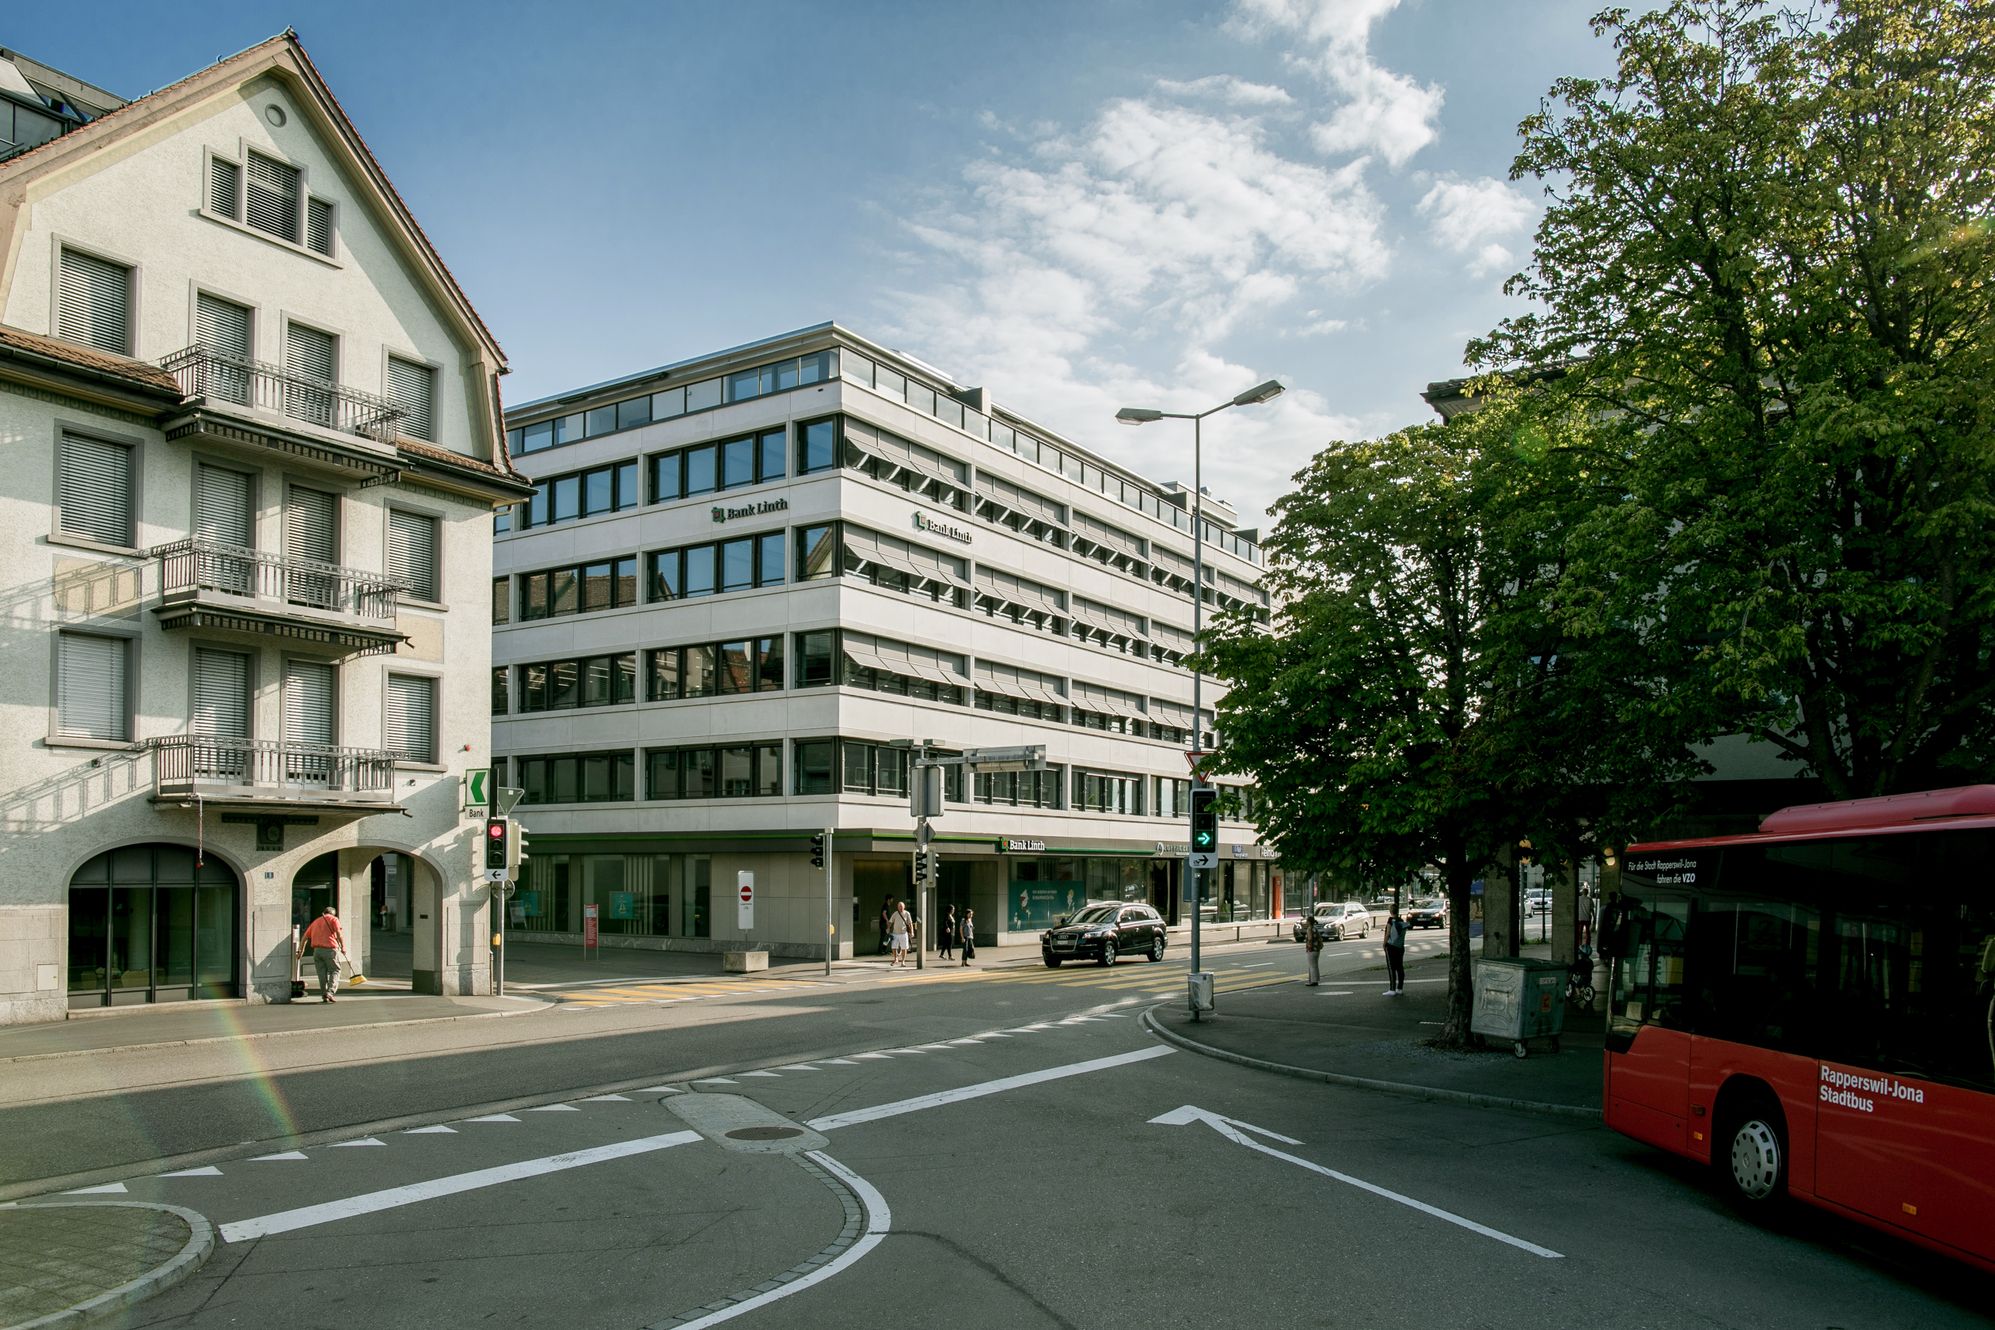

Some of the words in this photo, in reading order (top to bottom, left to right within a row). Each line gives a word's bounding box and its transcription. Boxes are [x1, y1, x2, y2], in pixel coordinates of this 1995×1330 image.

[727, 504, 756, 520] Bank
[757, 498, 788, 514] Linth
[927, 519, 950, 537] Bank
[469, 808, 484, 818] Bank
[1009, 839, 1027, 850] Bank
[1027, 840, 1045, 851] Linth
[1636, 861, 1644, 870] die
[1644, 860, 1656, 870] Stadt
[1657, 859, 1697, 871] Rapperswil-Jona
[1656, 874, 1672, 884] fahren
[1673, 874, 1681, 883] die
[1682, 873, 1696, 883] VZO
[1821, 1064, 1924, 1104] Rapperswil-Jona
[1820, 1084, 1874, 1113] Stadtbus
